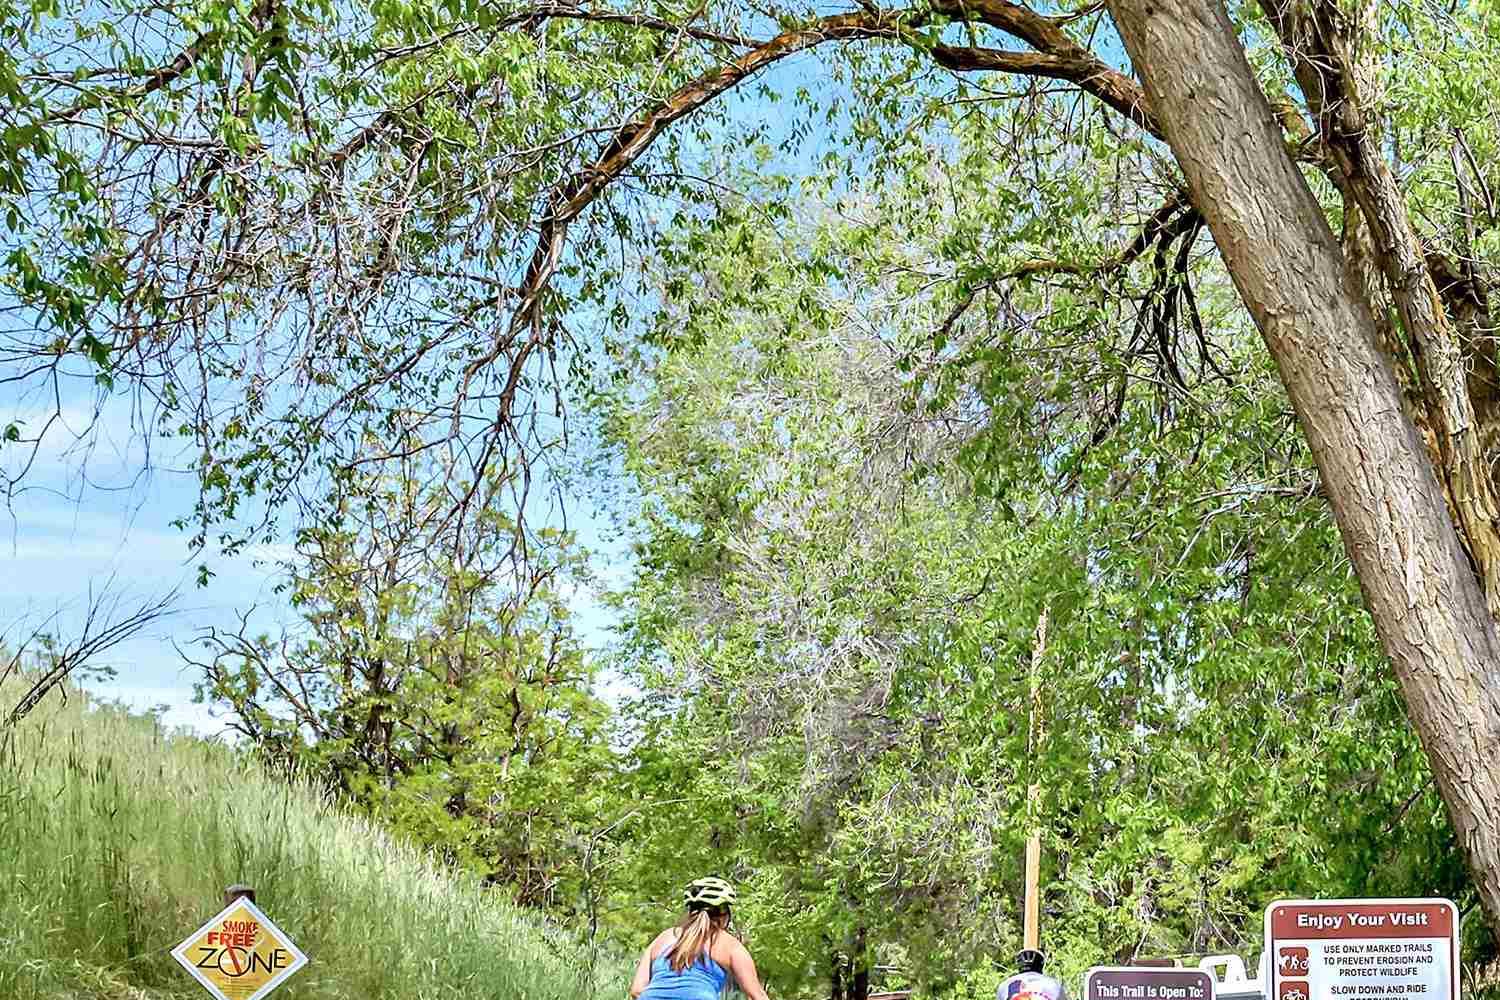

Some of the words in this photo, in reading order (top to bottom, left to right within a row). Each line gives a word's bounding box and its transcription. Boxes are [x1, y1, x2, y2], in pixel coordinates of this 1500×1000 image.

[222, 920, 259, 933] SMOKE
[1297, 914, 1342, 929] Enjoy
[1347, 913, 1385, 926] Your
[1390, 912, 1428, 925] Visit
[207, 932, 257, 946] FREE
[1324, 945, 1340, 953] USE
[1343, 945, 1364, 953] ONLY
[1366, 945, 1401, 953] MARKED
[1404, 944, 1433, 952] TRAILS
[196, 946, 287, 977] ZONE
[1324, 957, 1335, 965] TO
[1337, 957, 1375, 965] PREVENT
[1377, 956, 1413, 965] EROSION
[1416, 955, 1433, 963] AND
[1339, 968, 1377, 976] PROTECT
[1380, 967, 1418, 976] WILDLIFE
[1097, 985, 1119, 997] This
[1122, 985, 1145, 997] Trail
[1160, 986, 1185, 999] Open
[1188, 986, 1203, 998] To:
[1331, 986, 1356, 994] SLOW
[1359, 986, 1384, 994] DOWN
[1387, 985, 1404, 993] AND
[1407, 985, 1427, 993] RIDE
